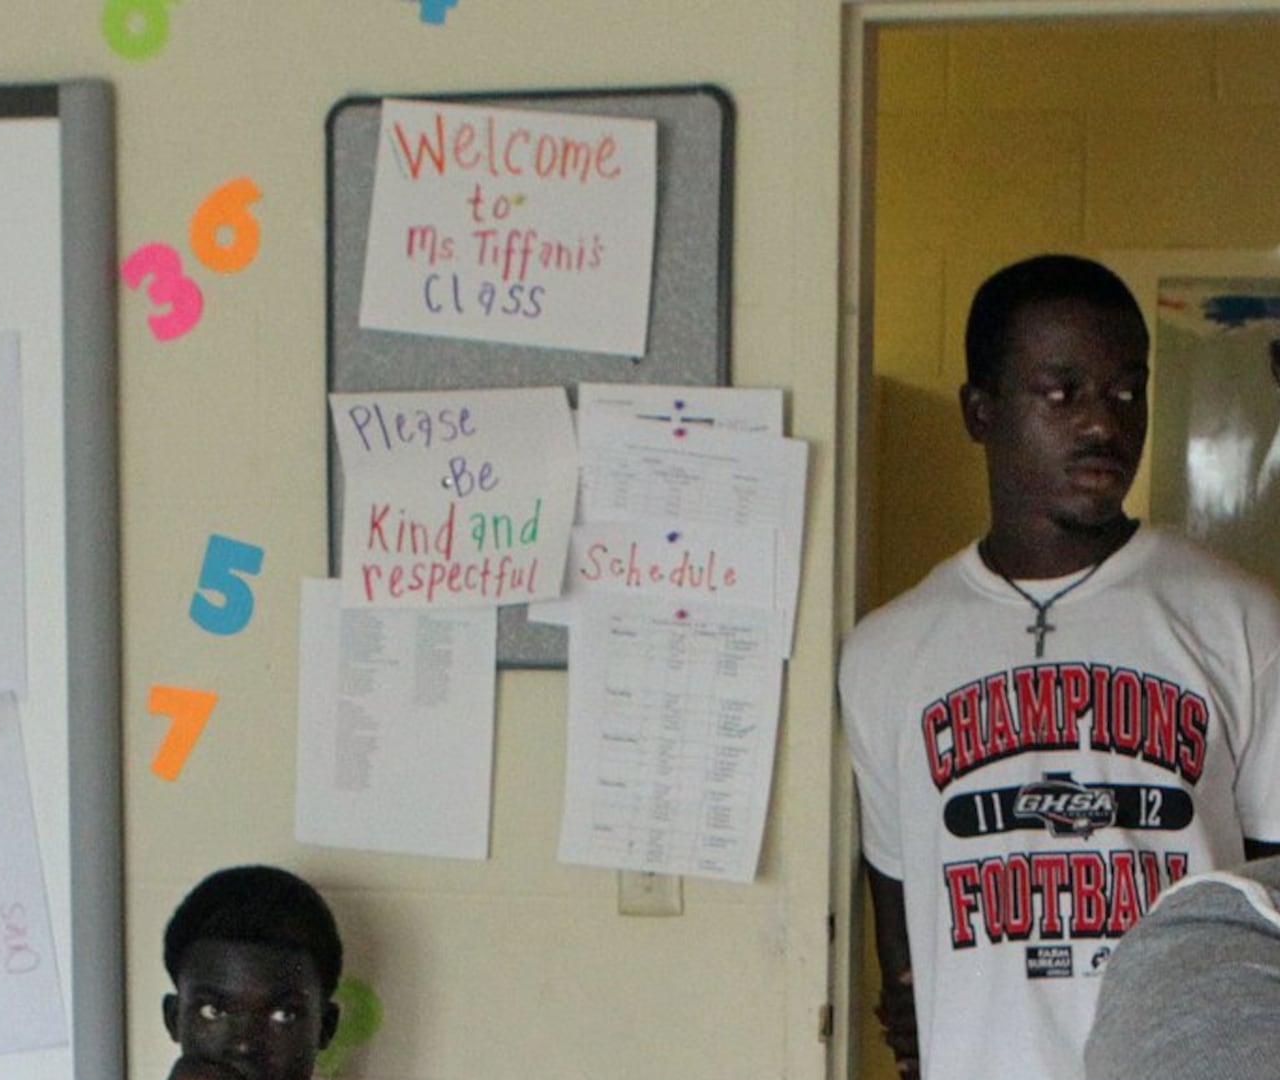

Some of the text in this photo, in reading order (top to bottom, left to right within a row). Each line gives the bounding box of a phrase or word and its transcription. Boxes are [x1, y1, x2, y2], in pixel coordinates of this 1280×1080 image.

[394, 114, 622, 183] Welcome
[189, 175, 262, 273] 6
[468, 184, 511, 223] to
[121, 242, 204, 342] 3
[424, 273, 548, 319] Class
[349, 404, 476, 451] Please
[449, 456, 500, 498] Be
[369, 498, 541, 560] Kind and
[189, 534, 264, 636] 5
[363, 555, 538, 602] respectful
[579, 542, 737, 591] Schedule
[147, 685, 218, 783] 7
[921, 661, 1210, 794] CHAMPIONS
[973, 787, 1162, 833] 11 GHSA 12
[943, 850, 1188, 950] FOOTBAL
